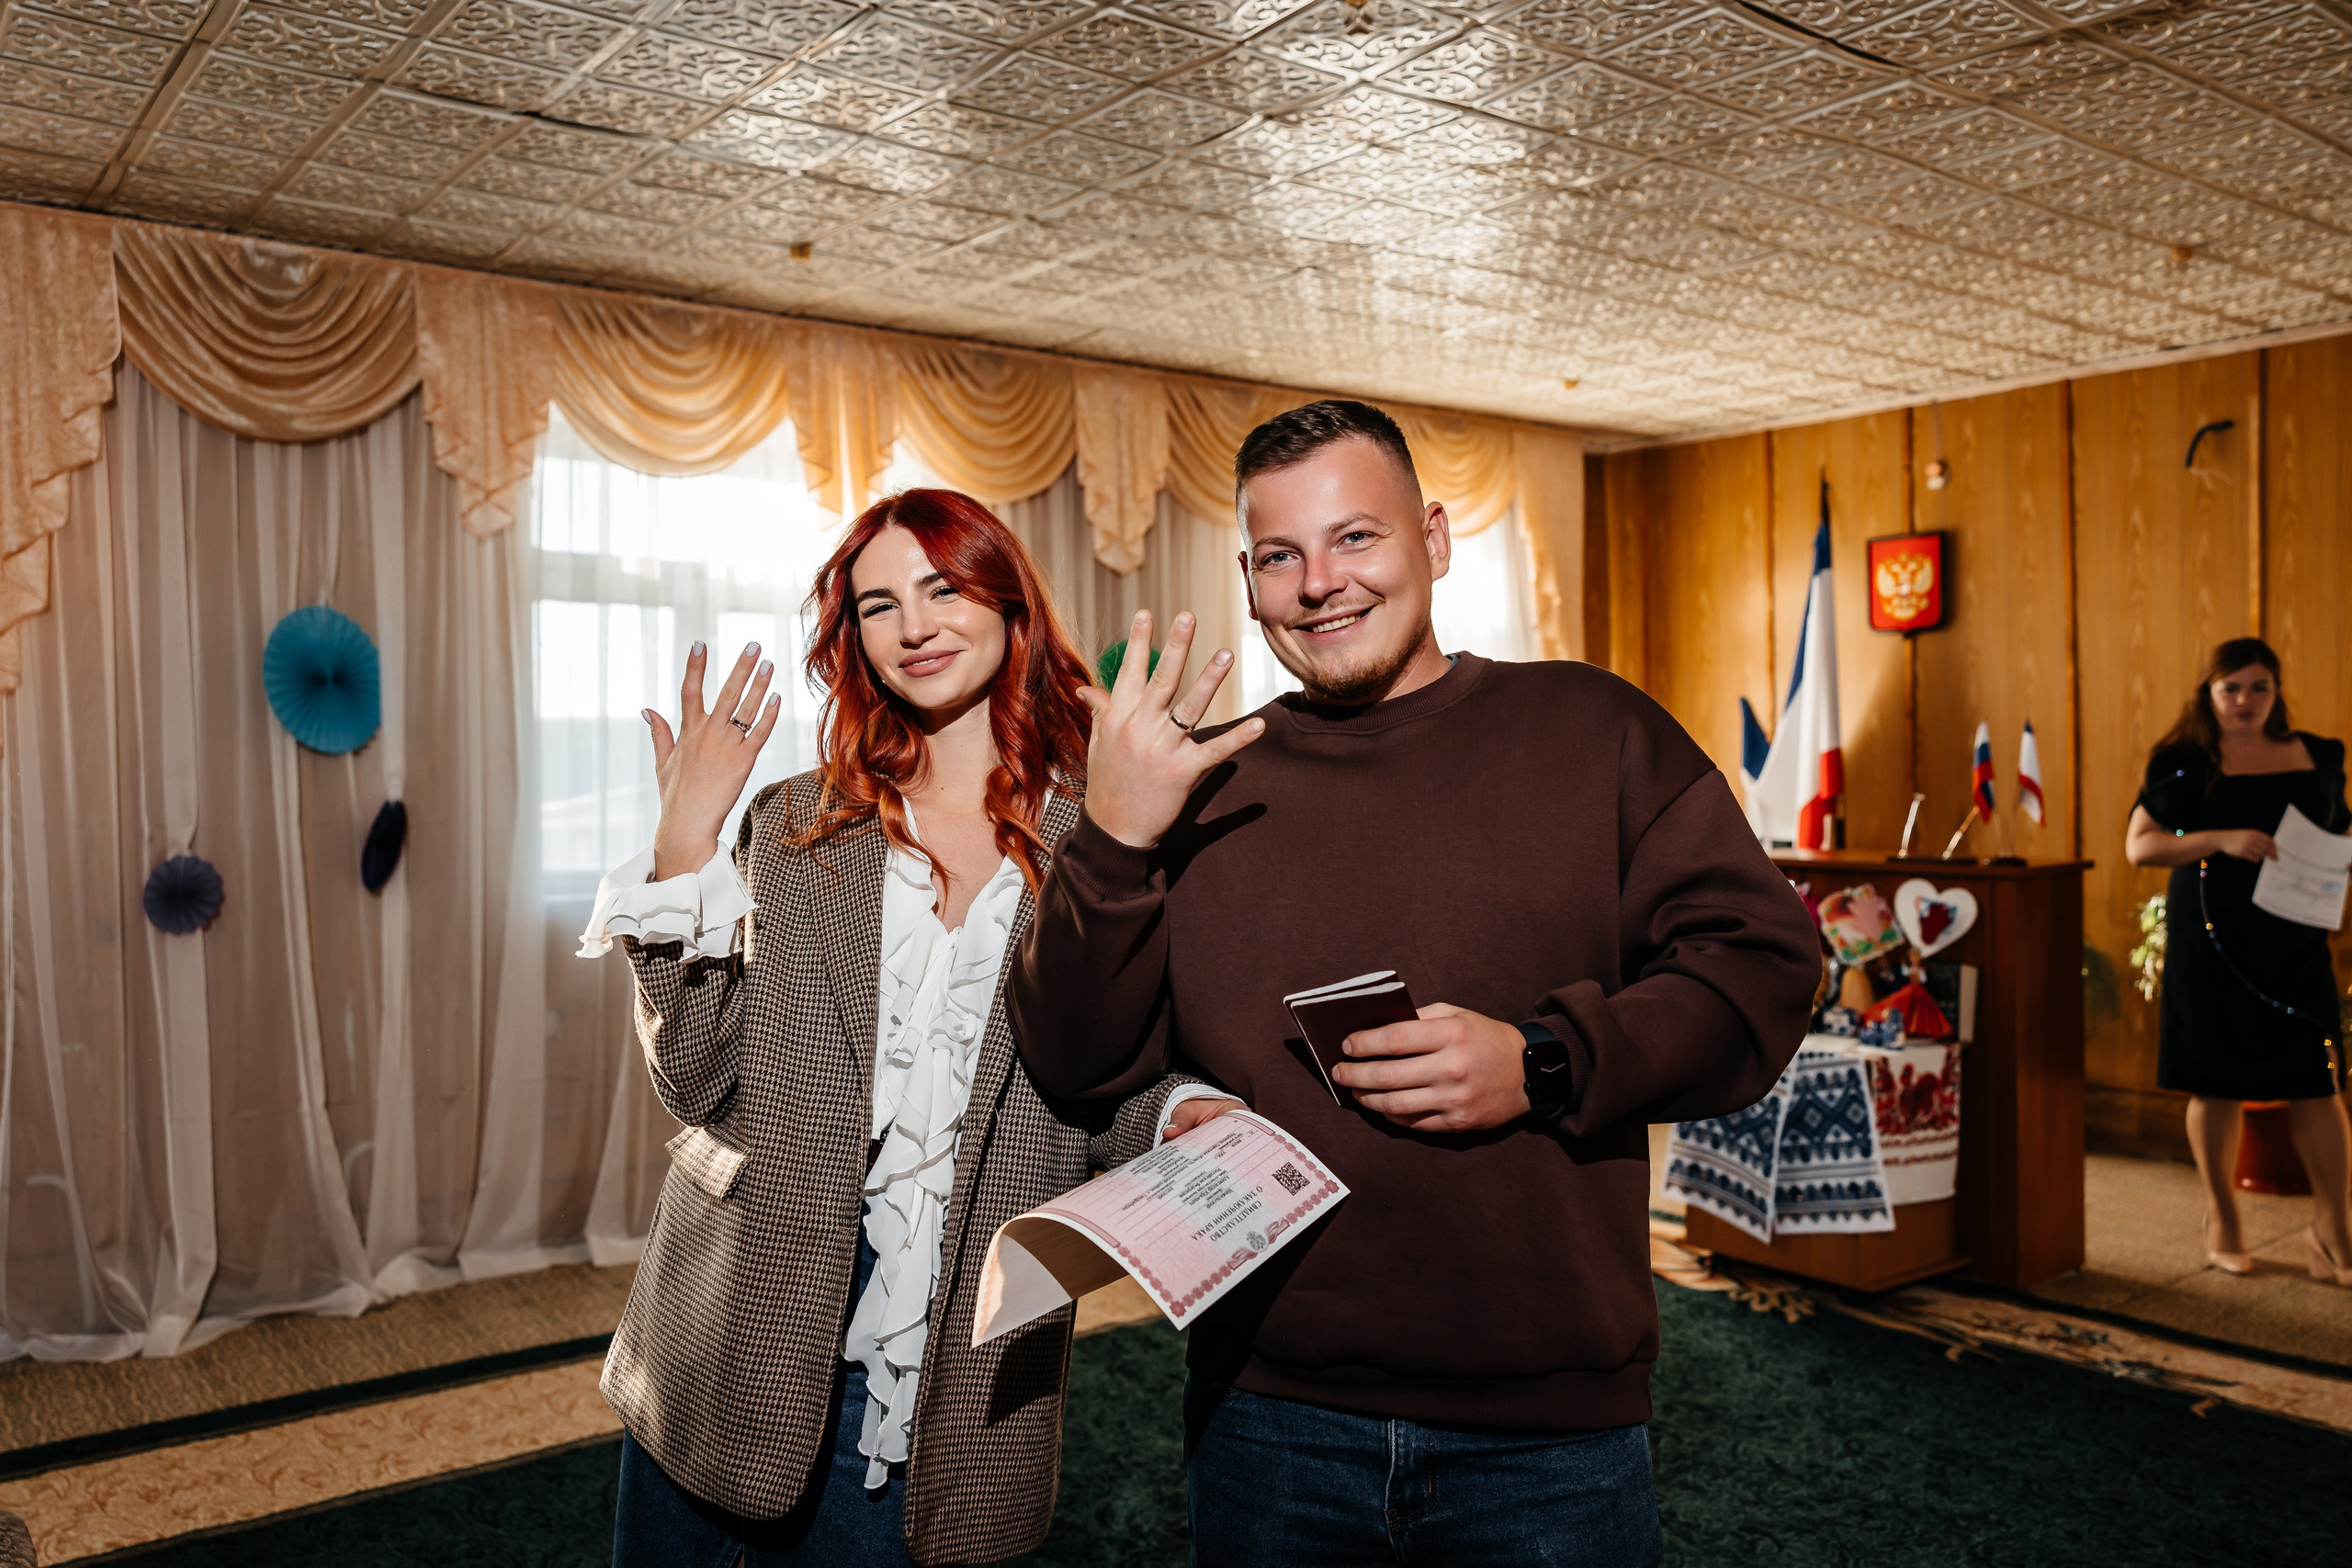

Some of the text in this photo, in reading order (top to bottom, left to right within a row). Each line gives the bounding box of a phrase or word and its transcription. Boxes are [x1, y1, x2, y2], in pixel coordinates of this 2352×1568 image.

[1190, 1184, 1263, 1242] О ЗАКЛЮЧЕНИИ БРАКА
[1208, 1199, 1262, 1243] СВИДЕТЕЛЬСТВО
